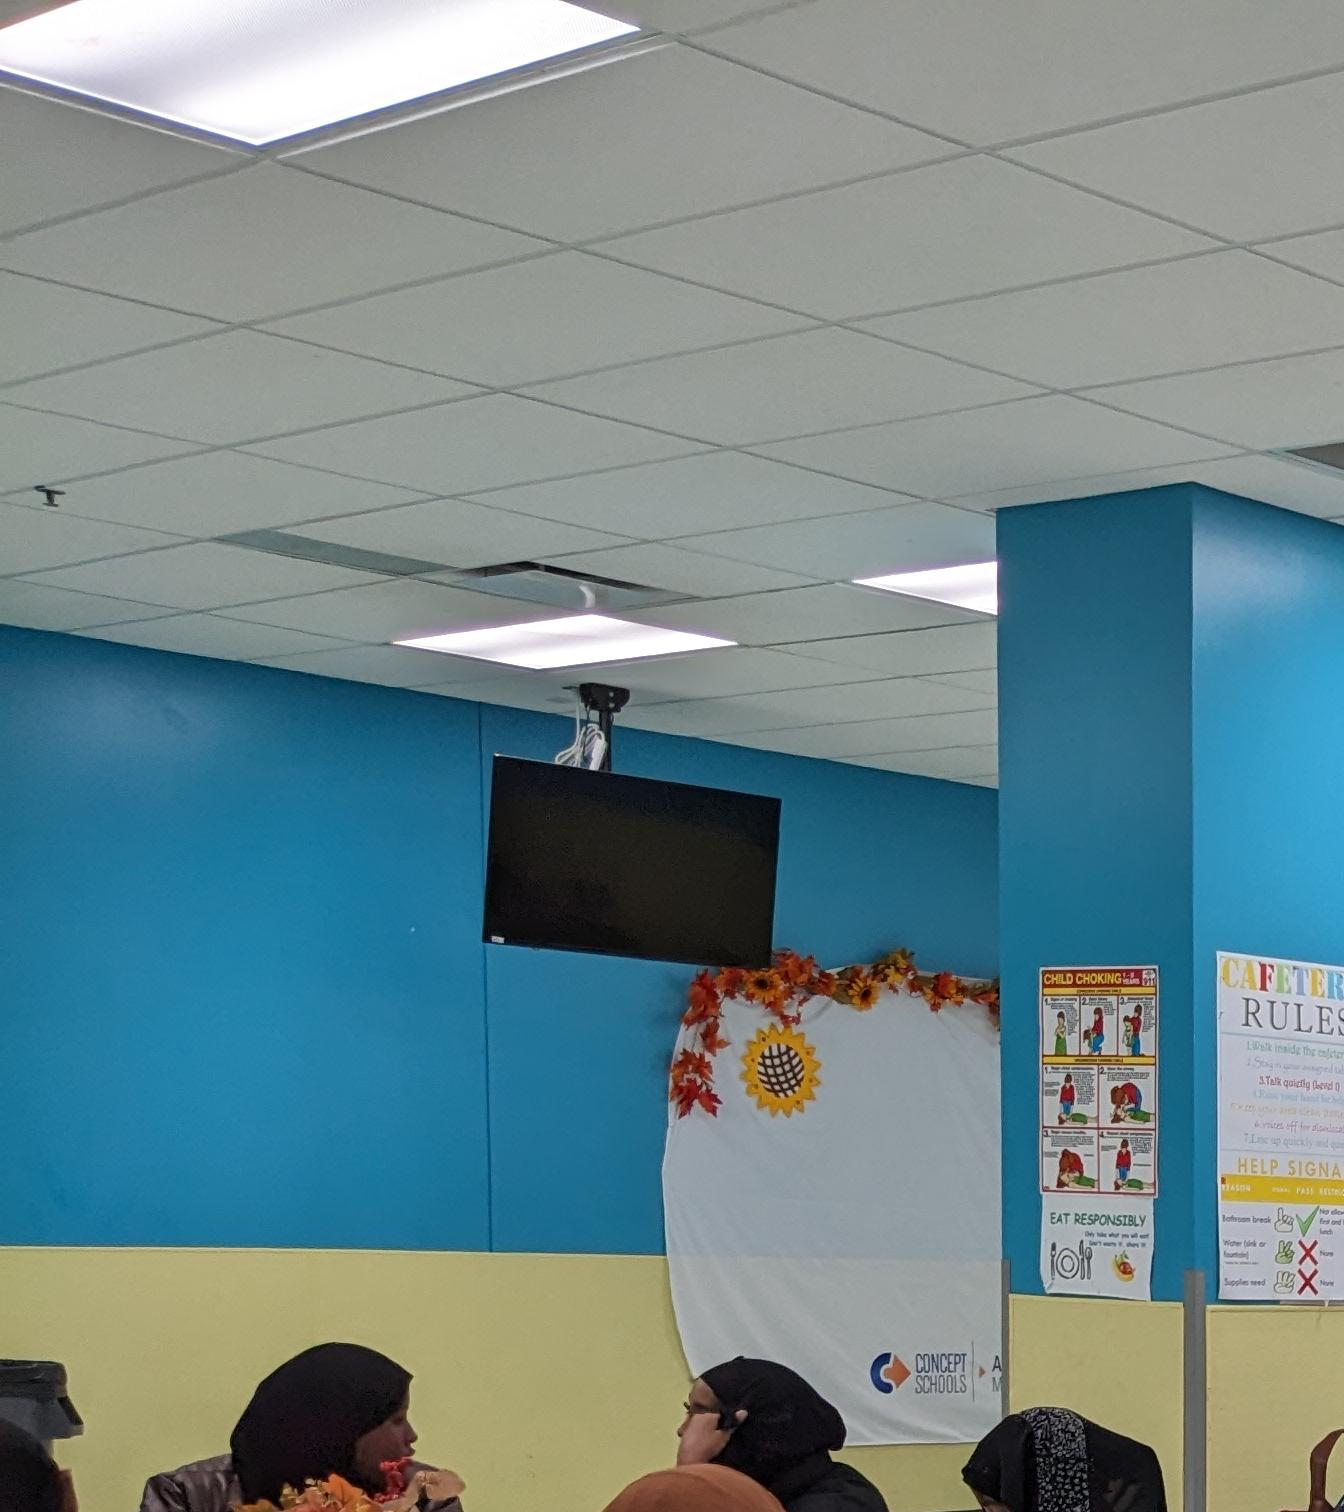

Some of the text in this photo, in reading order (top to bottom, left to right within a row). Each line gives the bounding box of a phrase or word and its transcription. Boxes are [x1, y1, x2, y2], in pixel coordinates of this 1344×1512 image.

[1043, 972, 1122, 985] CHILD CHOKING
[1238, 1157, 1278, 1175] HELP
[1050, 1212, 1146, 1227] EAT RESPONSIBLY
[915, 1353, 967, 1373] CONCEPT
[915, 1374, 967, 1394] SCHOOLS
